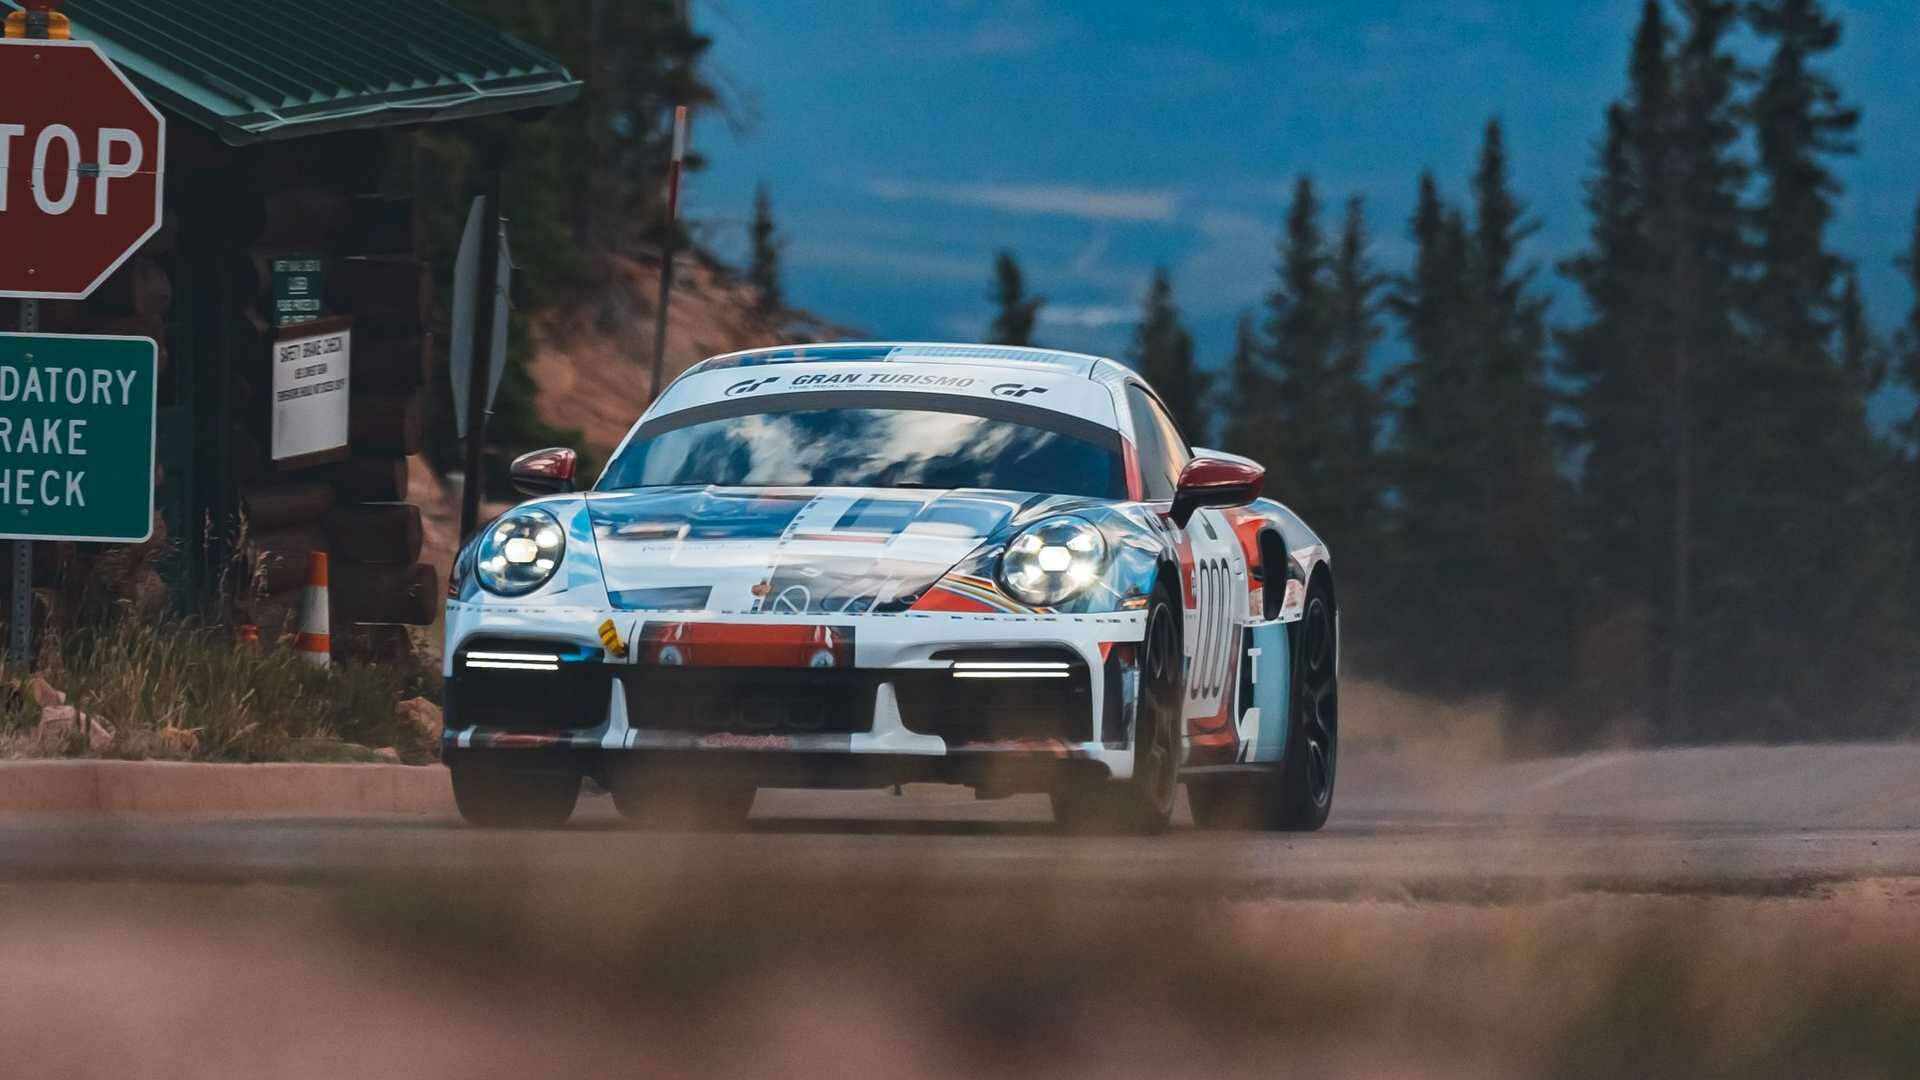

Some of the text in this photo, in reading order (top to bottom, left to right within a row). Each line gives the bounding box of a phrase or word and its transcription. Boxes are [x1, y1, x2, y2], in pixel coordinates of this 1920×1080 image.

[303, 340, 322, 358] BRAKE
[0, 366, 137, 406] DATORY
[792, 373, 863, 385] GRAN
[867, 373, 975, 387] TURISMO
[0, 417, 88, 455] RAKE
